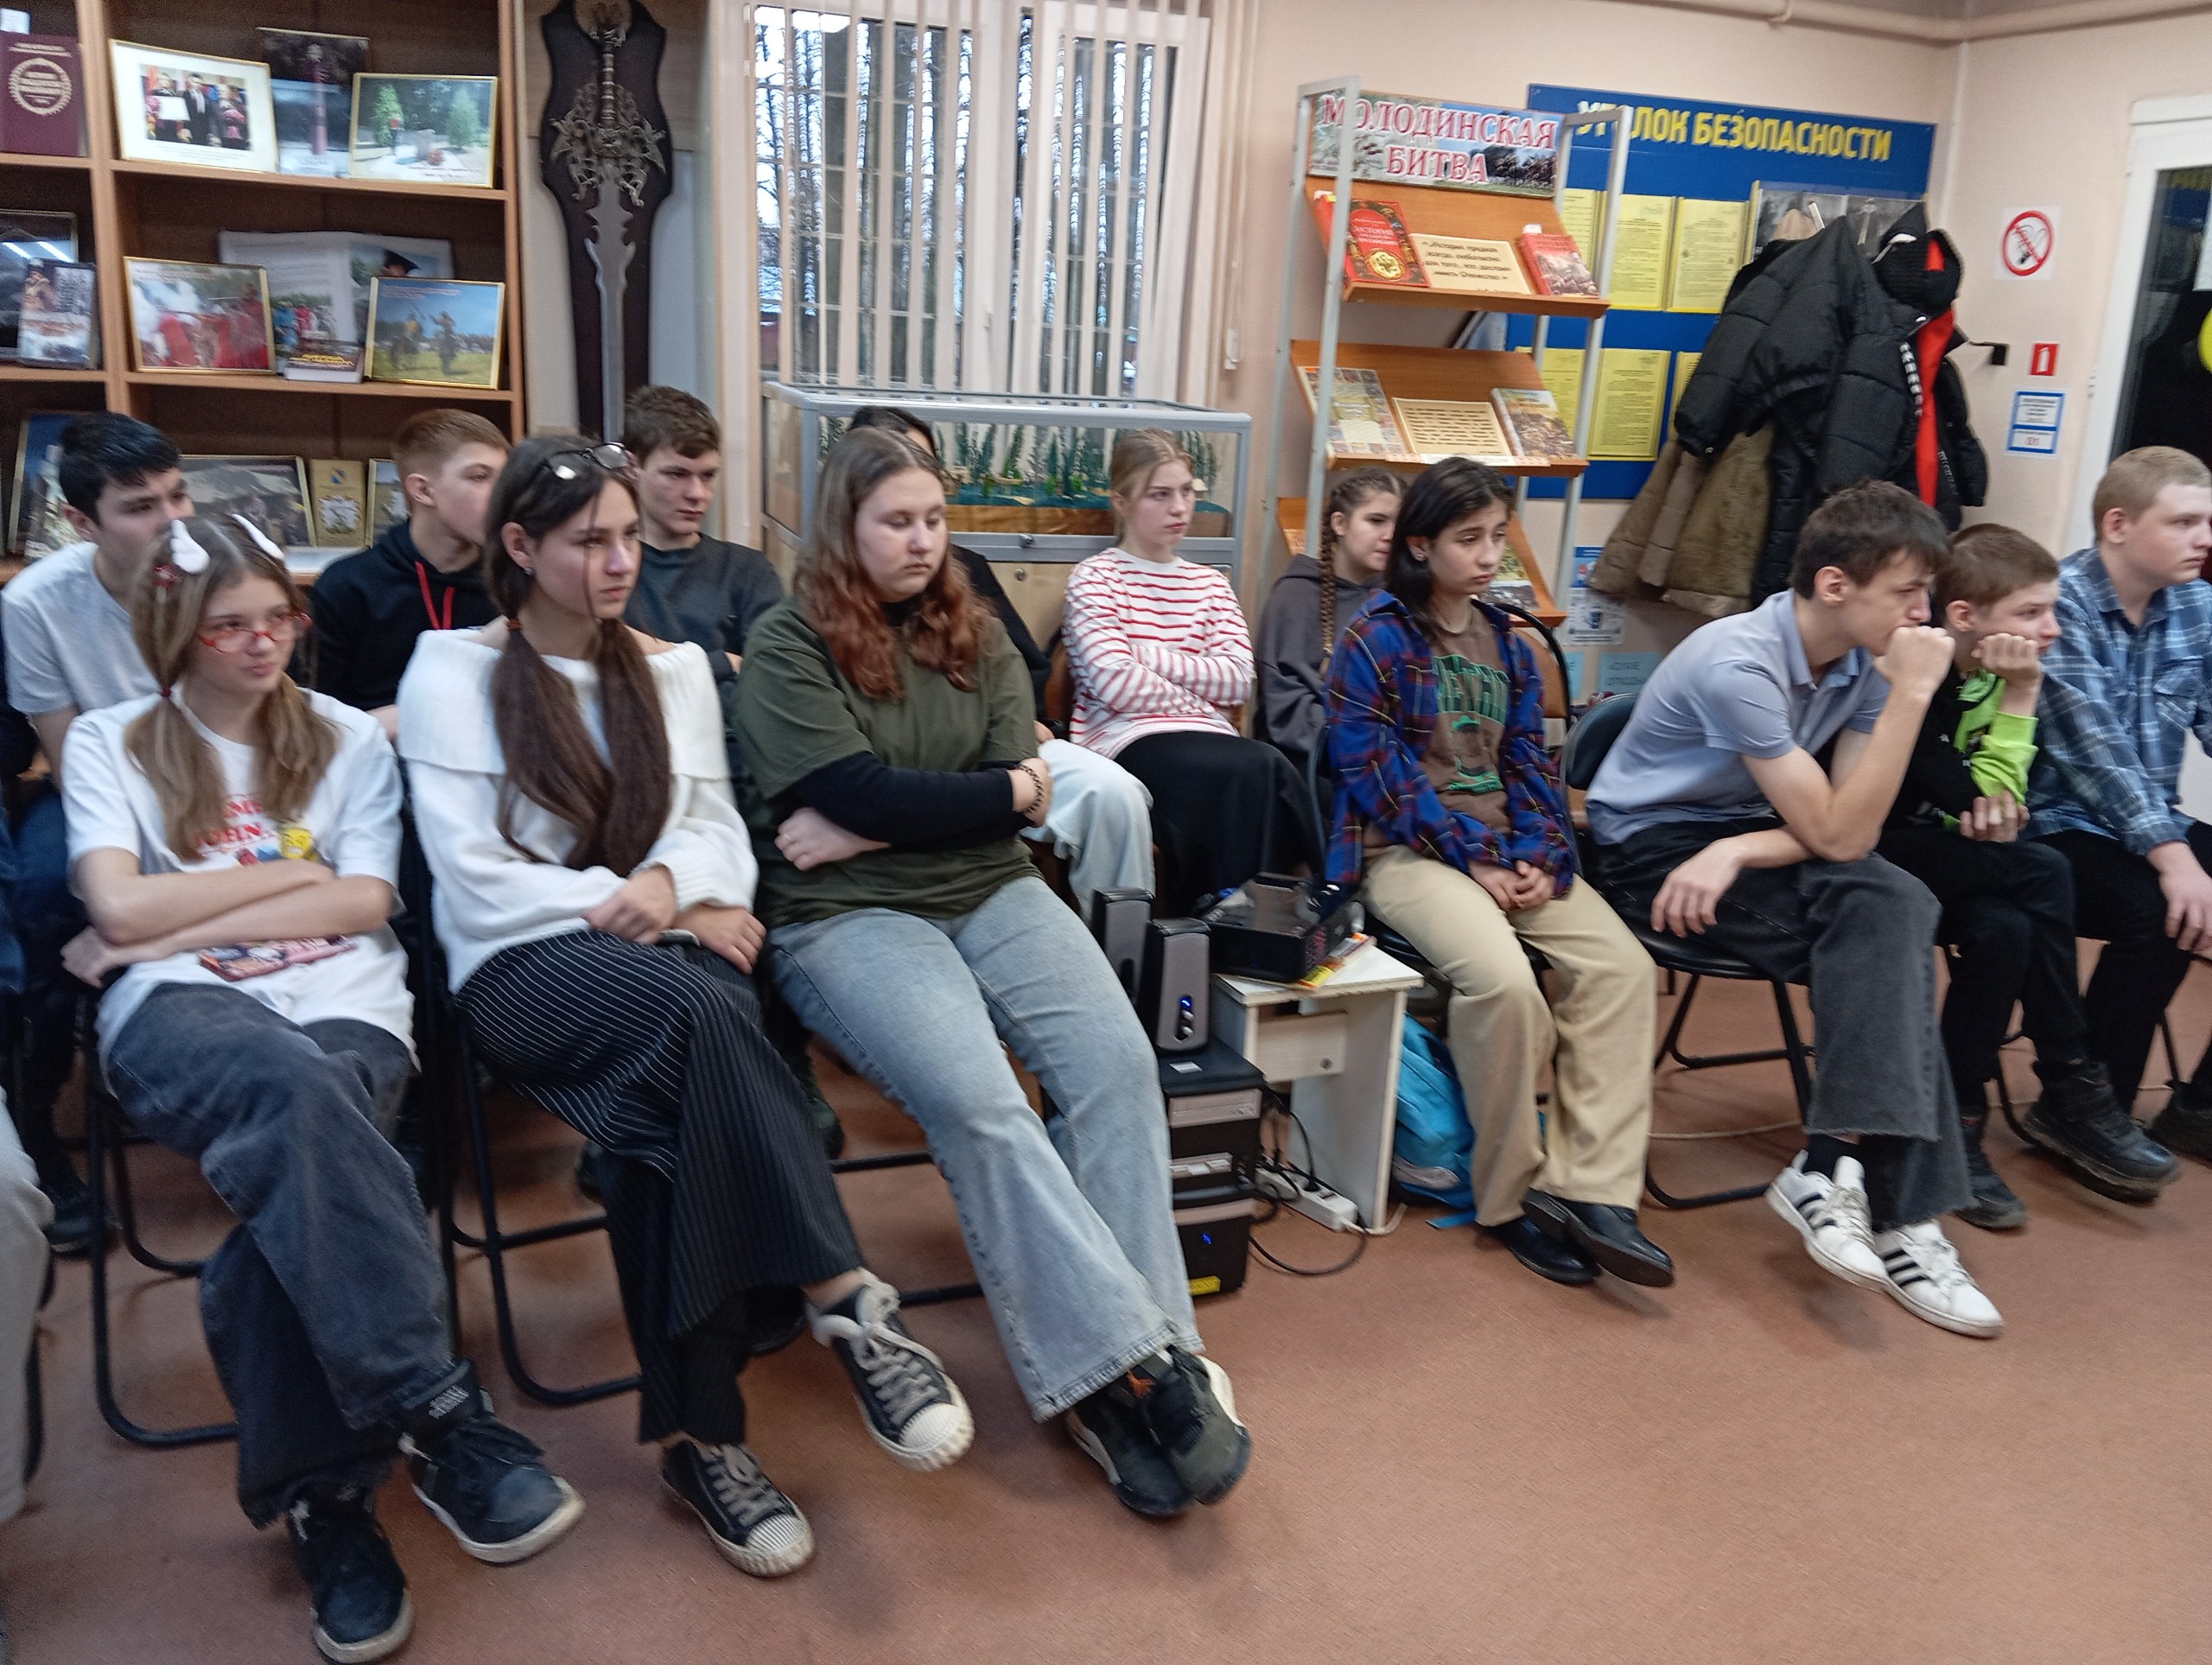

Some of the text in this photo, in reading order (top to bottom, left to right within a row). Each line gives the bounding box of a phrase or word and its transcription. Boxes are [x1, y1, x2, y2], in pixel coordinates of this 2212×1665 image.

[1322, 94, 1559, 149] МОЛОДИНСКАЯ
[1577, 100, 1893, 162] УГЛОК БЕЗОПАСНОСТИ
[1387, 144, 1489, 184] БИТВА
